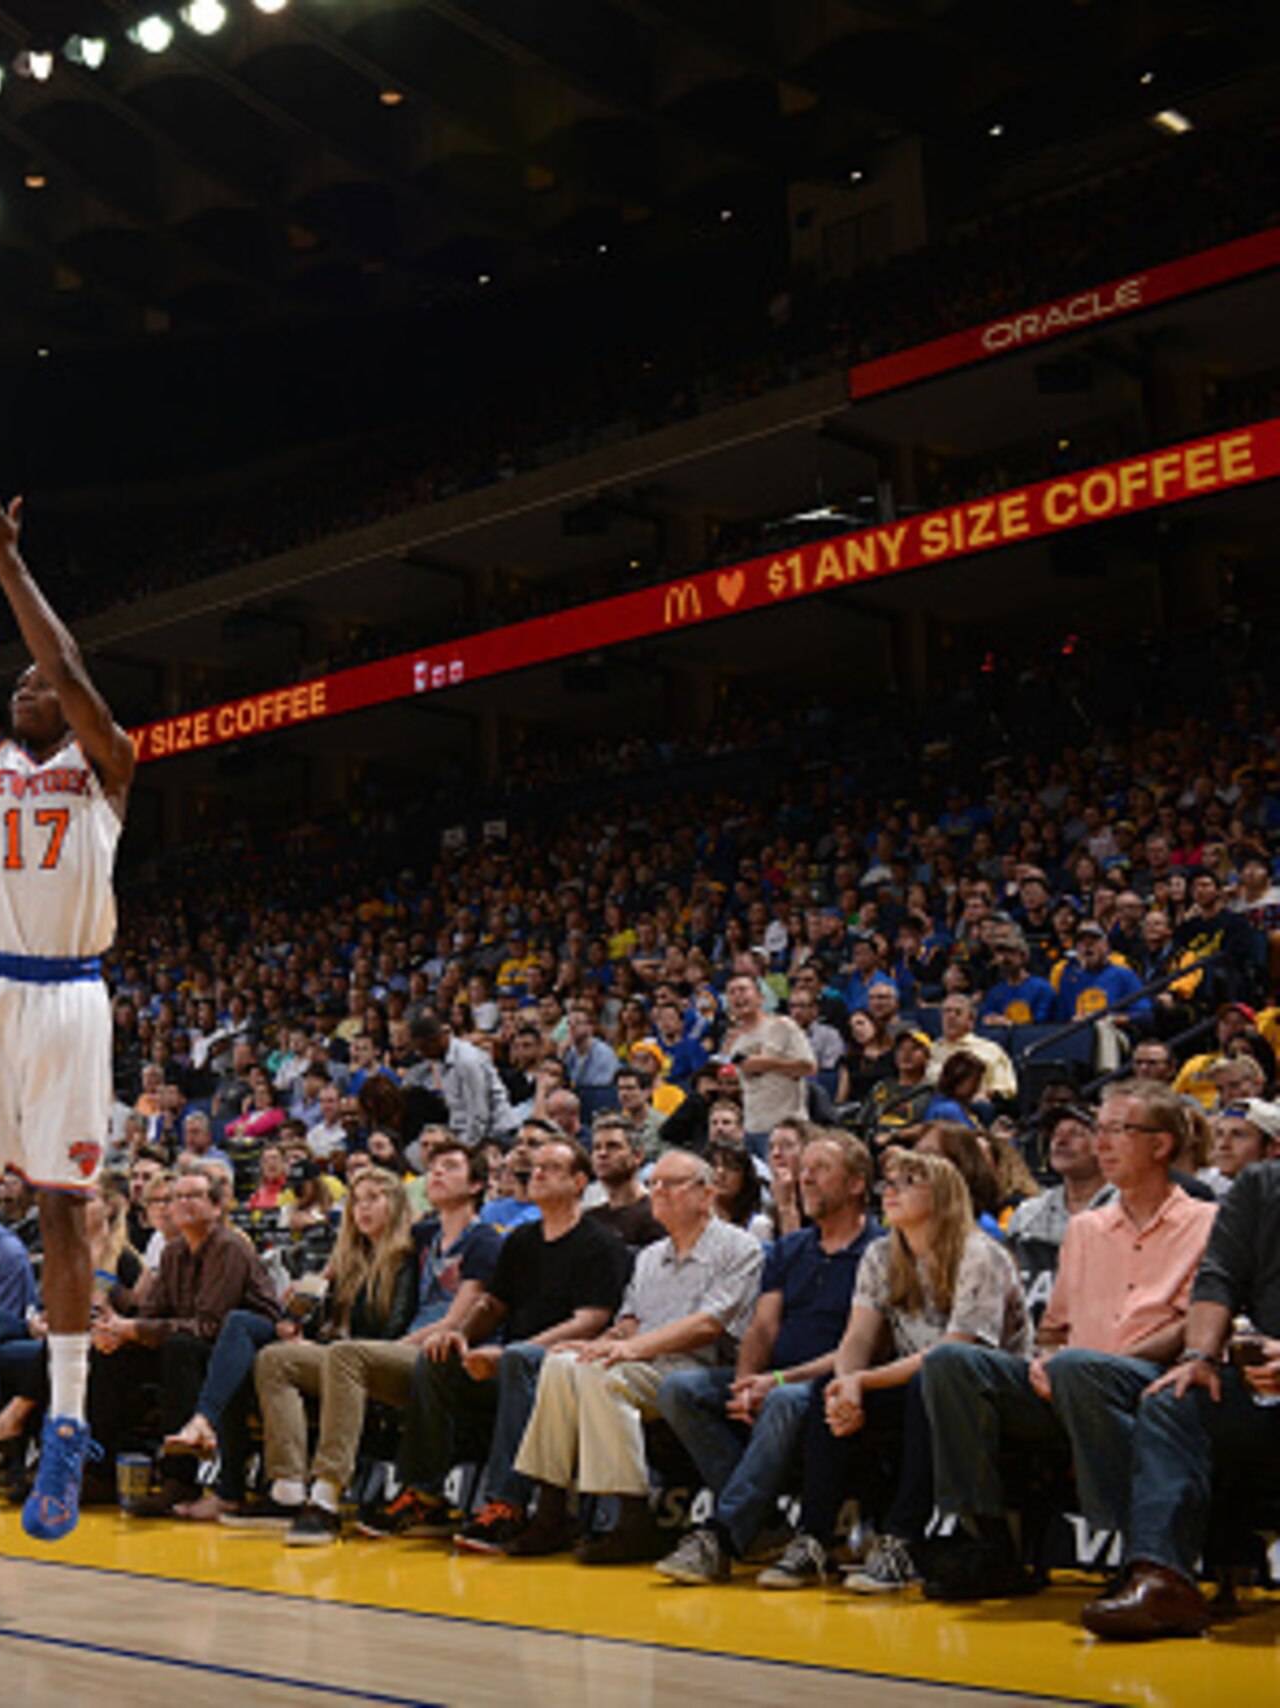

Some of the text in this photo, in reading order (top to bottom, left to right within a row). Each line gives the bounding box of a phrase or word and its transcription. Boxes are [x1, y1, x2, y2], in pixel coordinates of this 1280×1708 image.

[981, 279, 1141, 349] ORACLE
[768, 553, 804, 597] $1
[813, 526, 908, 586] ANY
[920, 494, 1030, 557] SIZE
[1043, 434, 1255, 526] COFFEE
[150, 712, 210, 754] SIZE
[216, 682, 326, 738] COFFEE
[4, 808, 69, 869] 17
